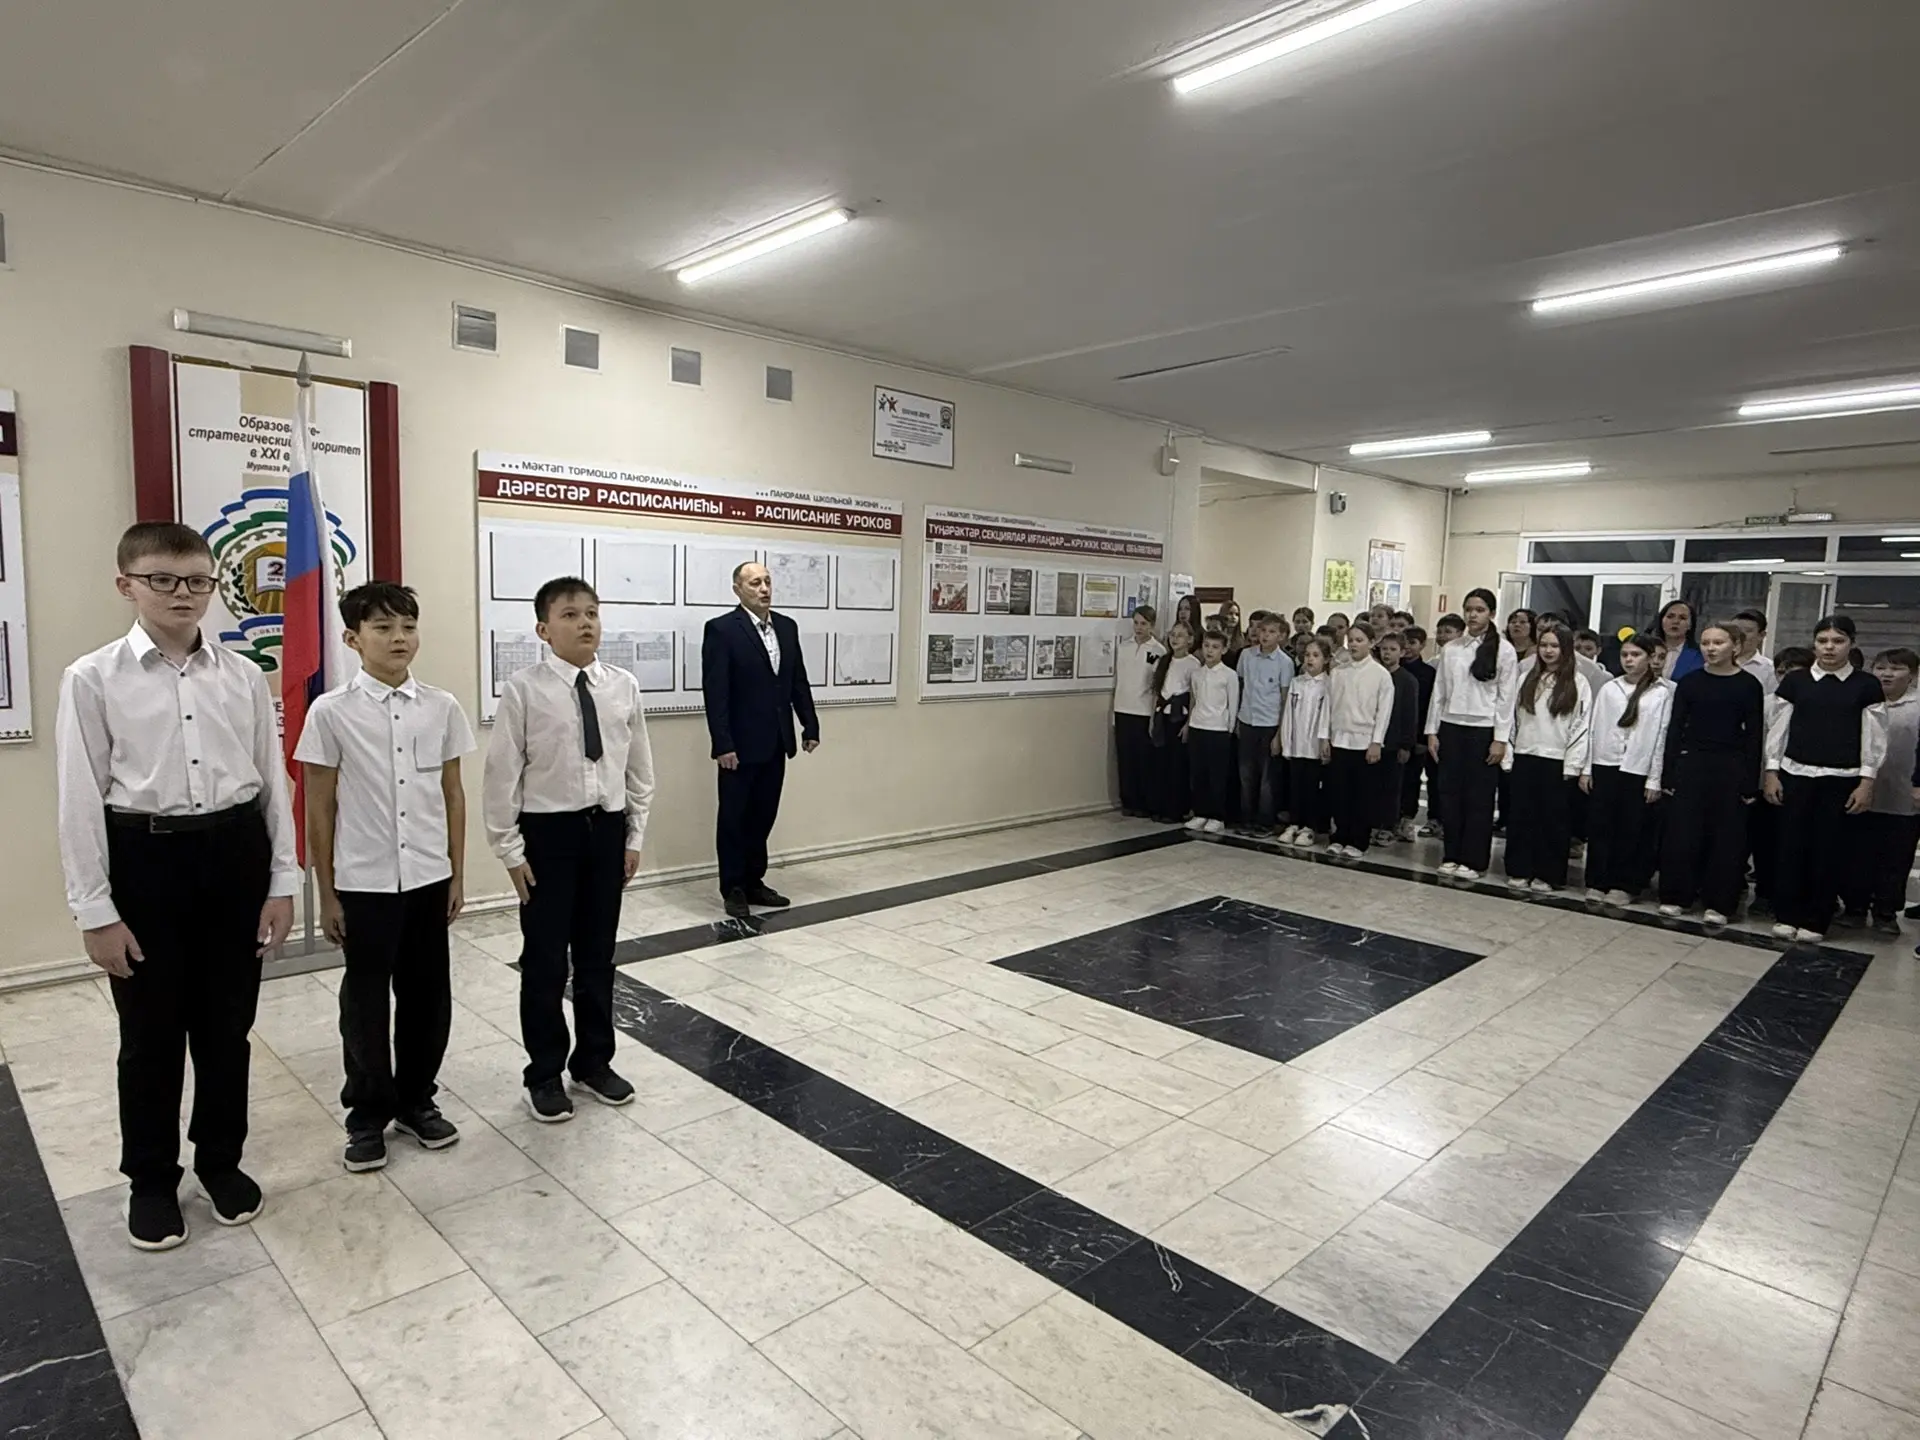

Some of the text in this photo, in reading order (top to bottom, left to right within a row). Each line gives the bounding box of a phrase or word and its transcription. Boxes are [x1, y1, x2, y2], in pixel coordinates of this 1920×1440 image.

[239, 415, 320, 437] Образове-
[188, 427, 361, 456] стратегически иоритет
[260, 447, 280, 460] XXI
[497, 478, 590, 502] ДӘРЕСТӘР
[756, 505, 841, 525] РАСПИСАНИЕ
[846, 515, 892, 530] УРОКОВ
